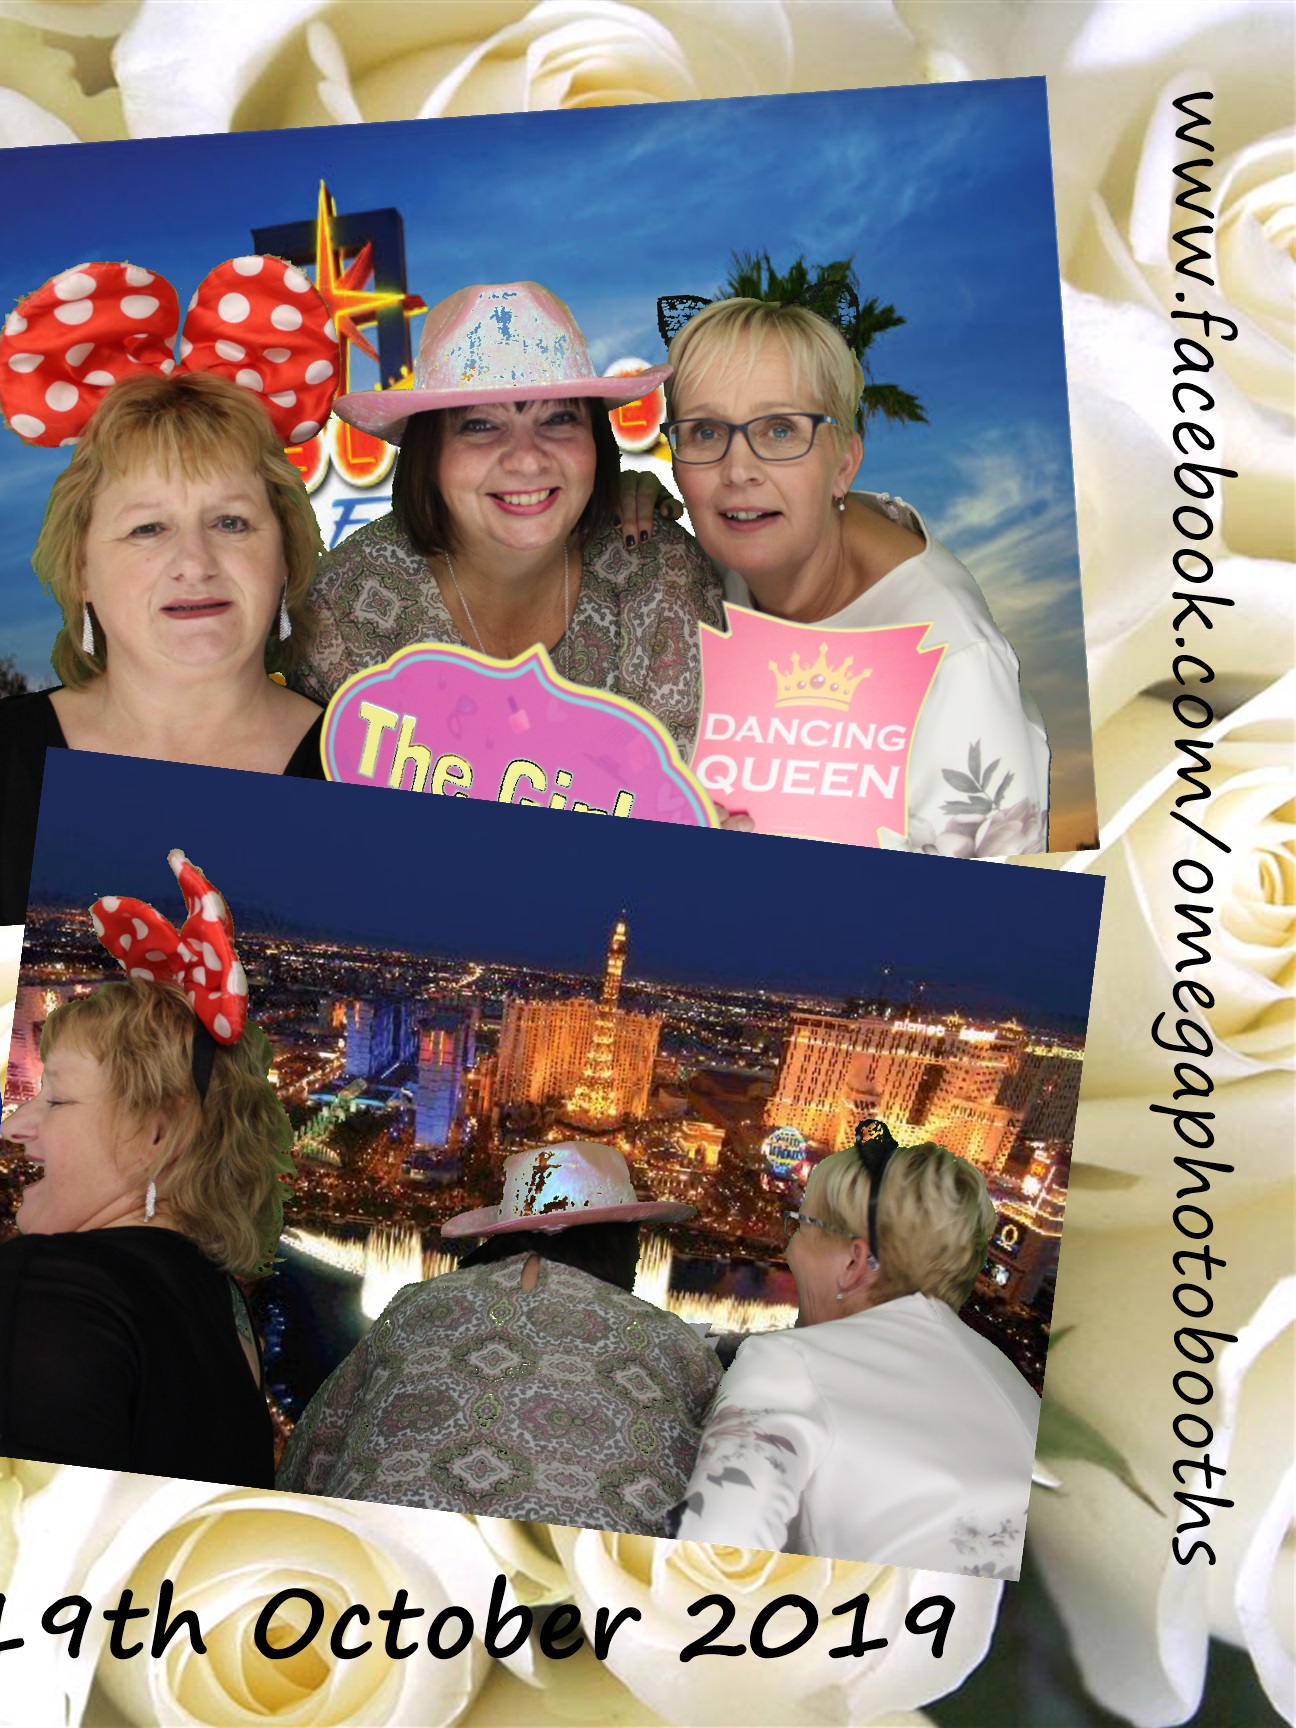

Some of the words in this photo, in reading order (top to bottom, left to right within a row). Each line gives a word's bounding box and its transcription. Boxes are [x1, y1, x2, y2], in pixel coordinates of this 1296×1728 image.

[357, 700, 474, 799] The
[703, 713, 908, 752] DANCING
[696, 754, 902, 799] QUEEN
